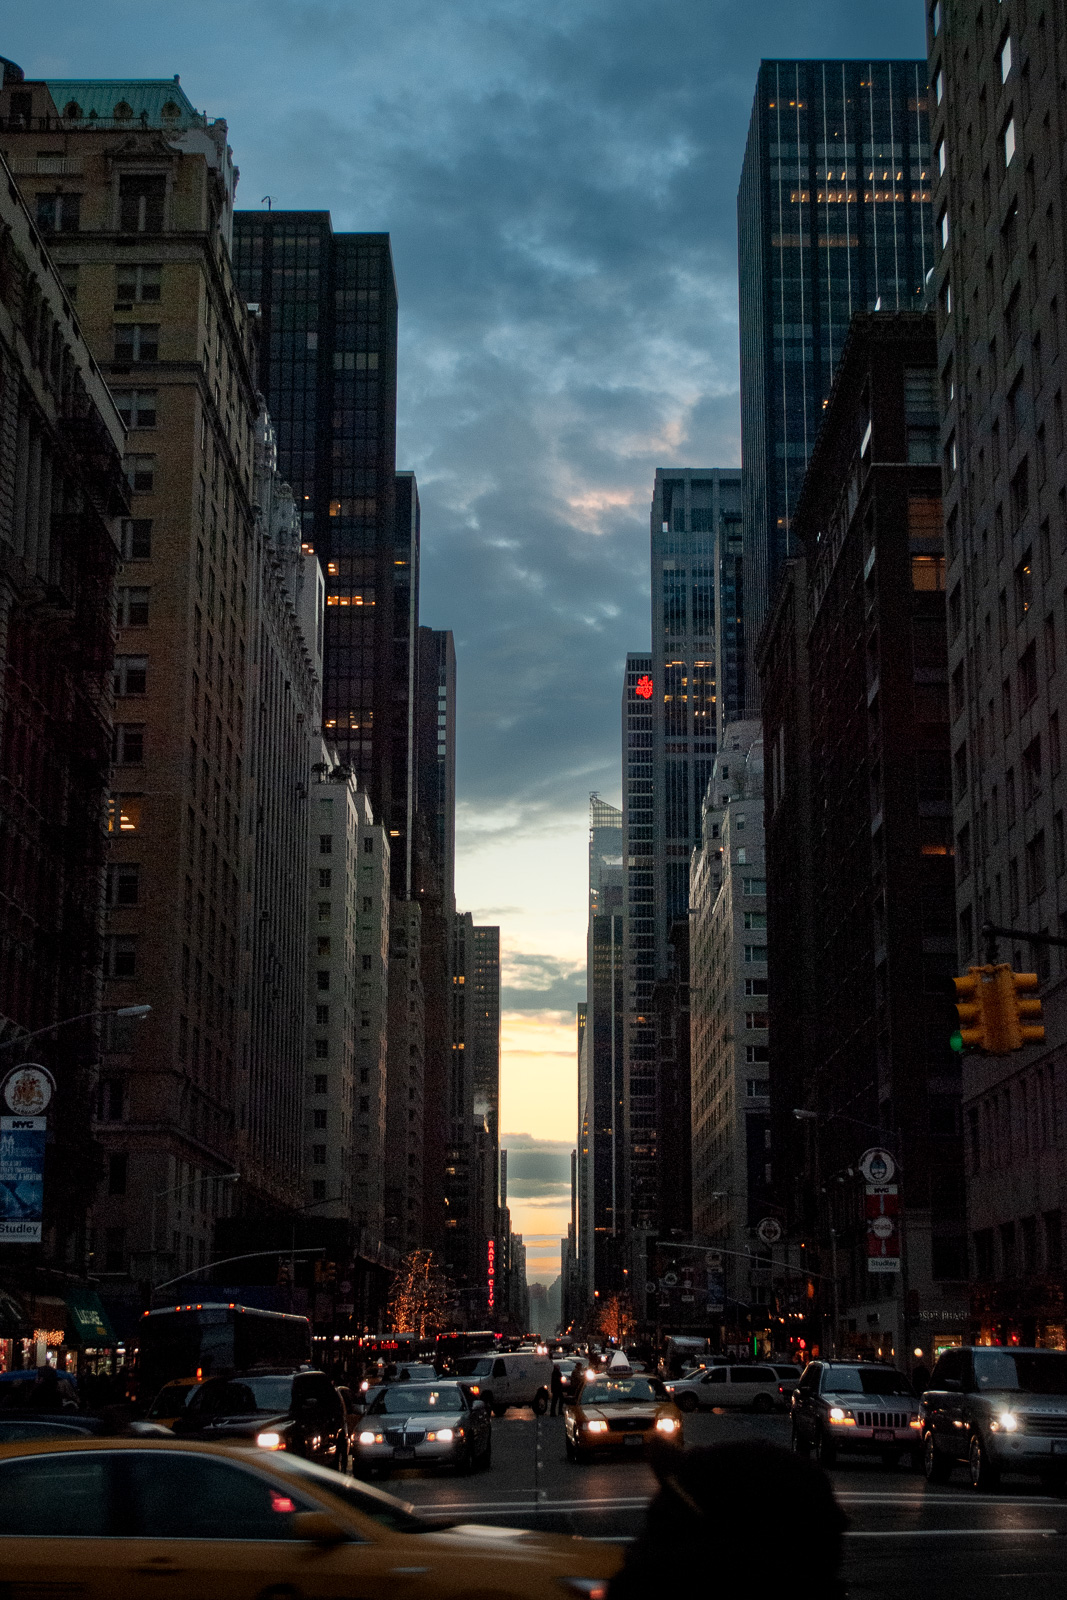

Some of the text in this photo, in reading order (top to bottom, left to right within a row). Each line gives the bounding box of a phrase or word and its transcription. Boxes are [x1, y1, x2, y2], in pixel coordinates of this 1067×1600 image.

[12, 1120, 33, 1129] NYC
[0, 1223, 38, 1236] Studley
[487, 1240, 496, 1275] RADIO
[871, 1259, 897, 1268] Studley
